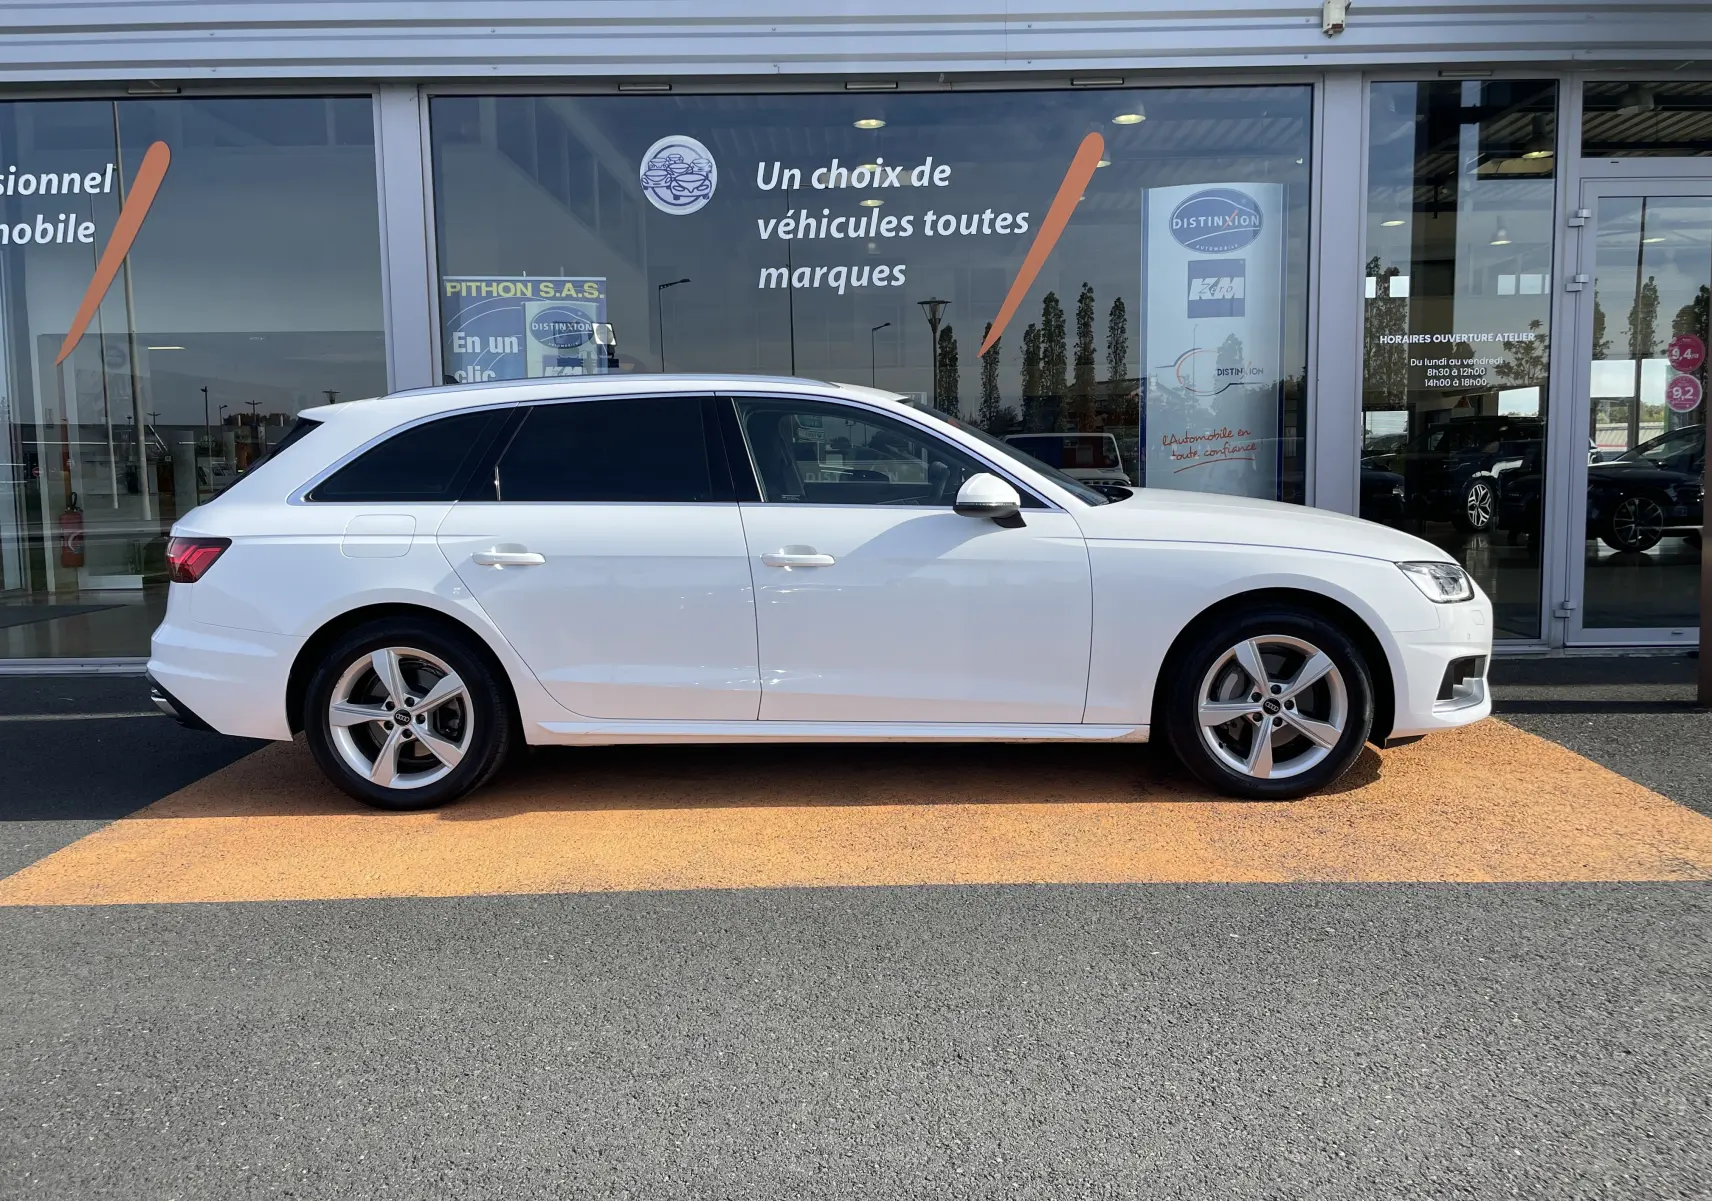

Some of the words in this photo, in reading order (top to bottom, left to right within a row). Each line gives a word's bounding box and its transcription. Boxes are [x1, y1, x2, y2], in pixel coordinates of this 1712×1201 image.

[757, 161, 801, 190] Un
[811, 157, 903, 189] choix
[911, 156, 951, 187] de
[758, 208, 914, 240] véhicules
[924, 208, 1030, 236] toutes
[1173, 211, 1260, 229] DISTINXION
[758, 263, 907, 295] marques
[446, 282, 533, 297] PITHON
[539, 282, 605, 298] S.A.S.
[532, 320, 592, 332] DISTINXION
[453, 331, 481, 353] En
[489, 336, 518, 353] un
[1380, 334, 1431, 344] HORAIRES
[1433, 333, 1493, 343] OUVERTURE
[1496, 332, 1535, 342] ATELIER
[1410, 358, 1423, 366] Du
[1424, 357, 1447, 366] lundi
[1463, 357, 1503, 365] vendredi
[454, 366, 496, 383] clic
[1217, 364, 1263, 377] DISTINXION
[1427, 368, 1450, 376] 8h30
[1451, 368, 1458, 376] à
[1460, 367, 1486, 376] 12h00
[1424, 379, 1451, 387] 14h00
[1453, 378, 1459, 386] à
[1461, 378, 1487, 386] 18h00
[1162, 427, 1234, 446] l'Automobile
[1237, 429, 1252, 437] en
[1172, 446, 1200, 460] toute
[1204, 442, 1258, 457] confiance
